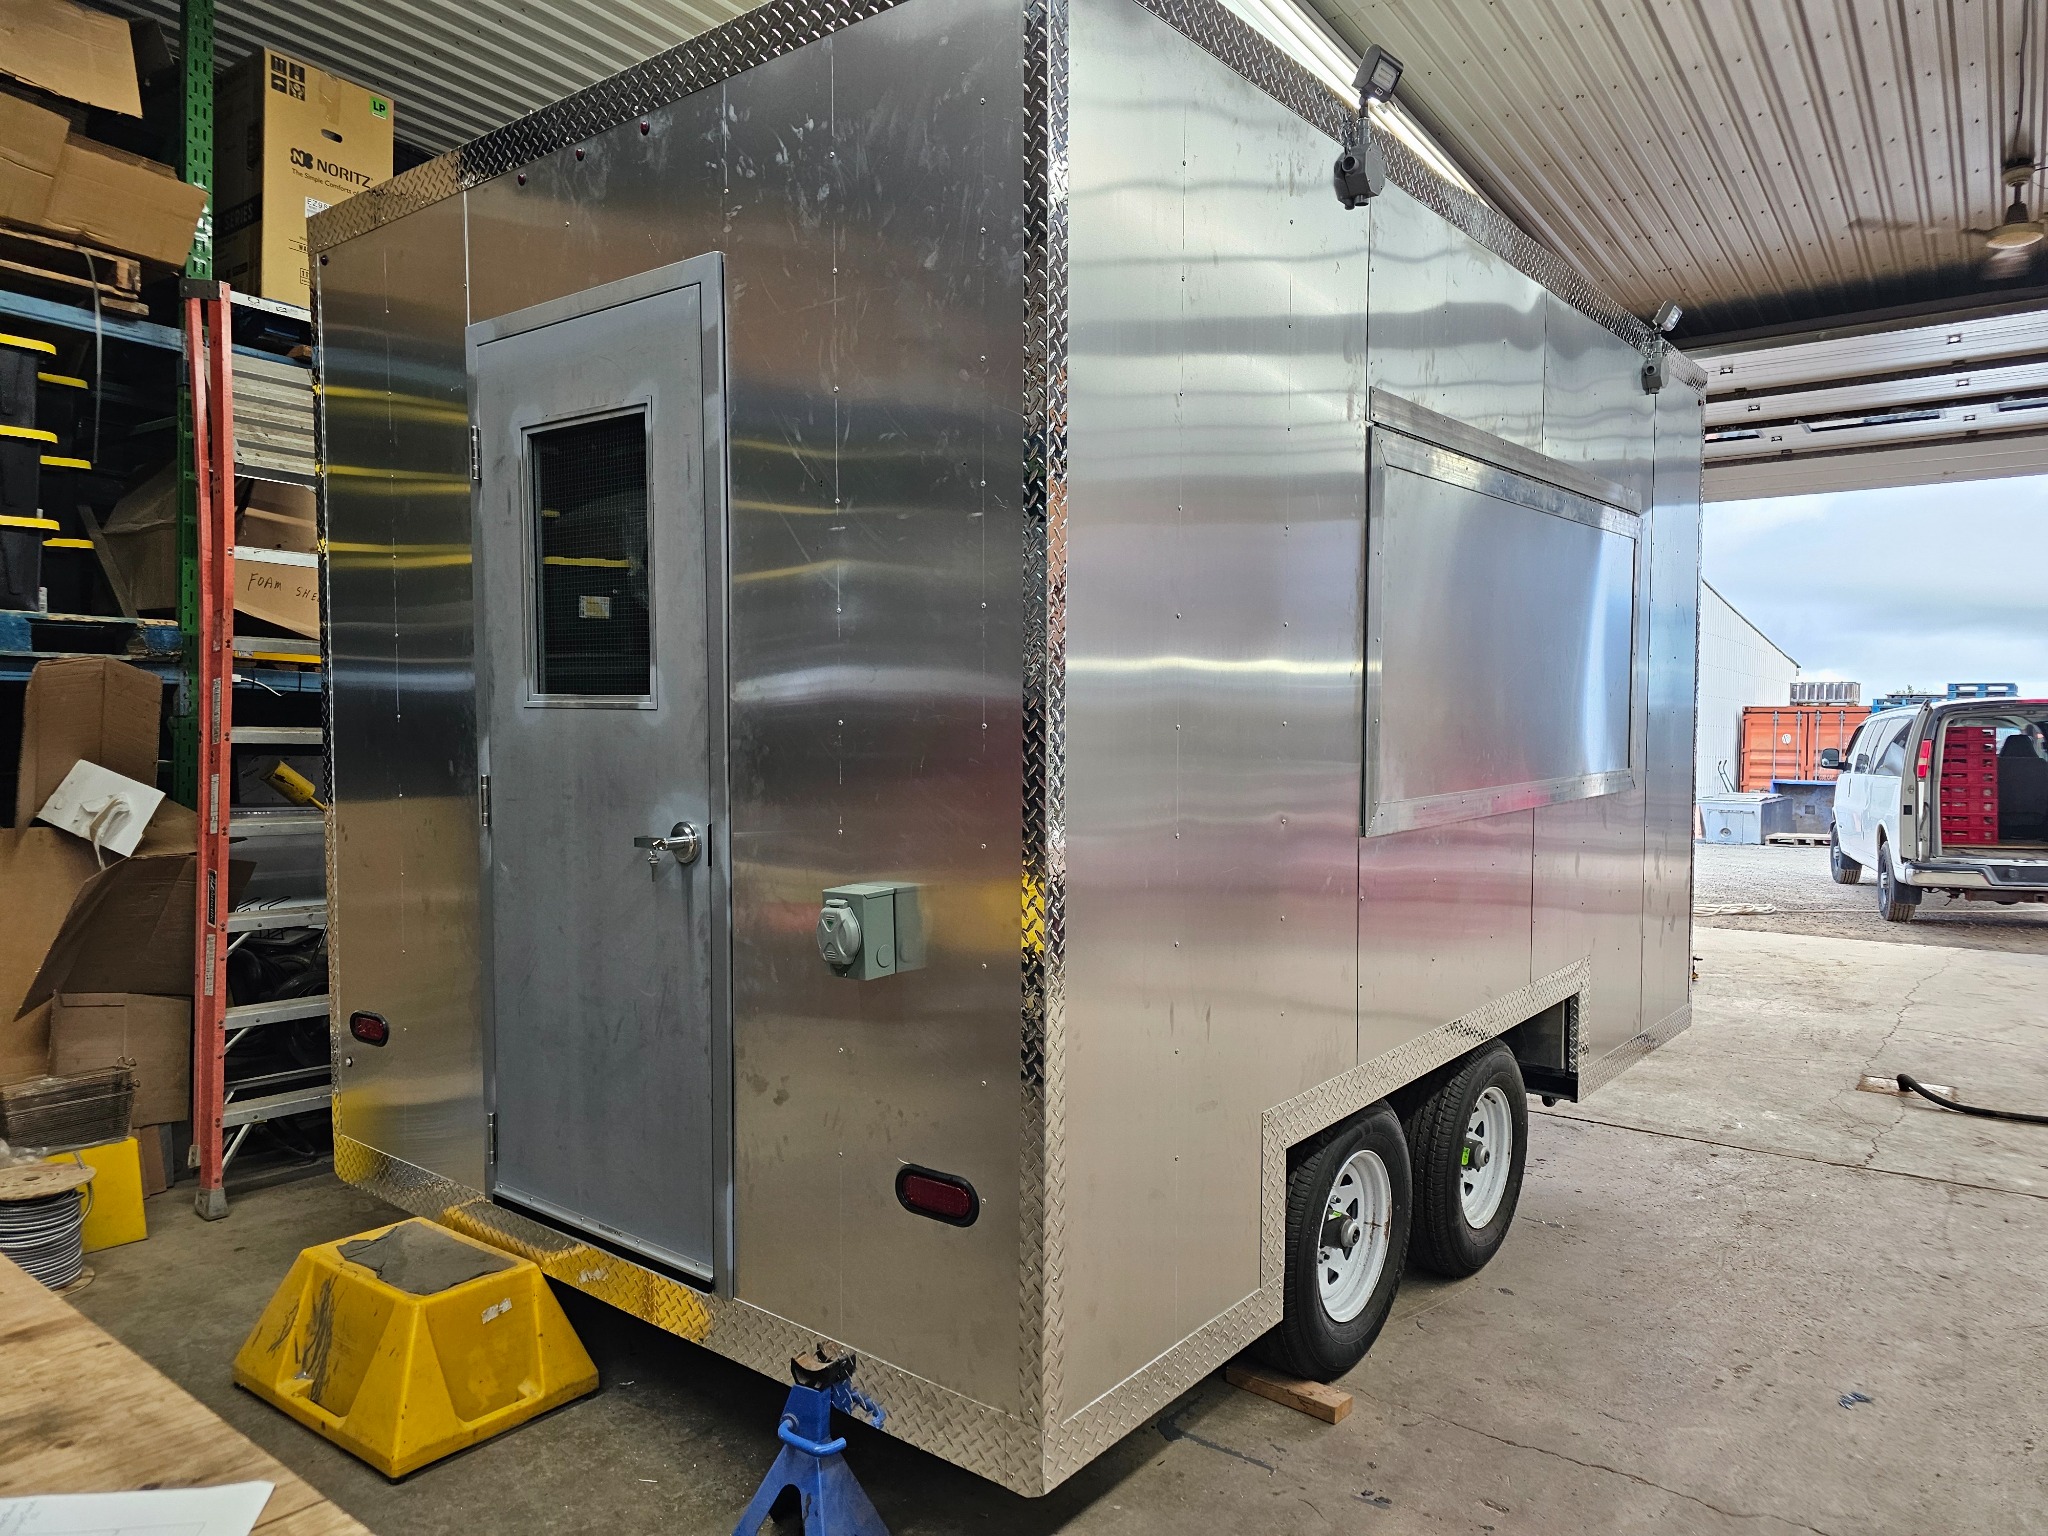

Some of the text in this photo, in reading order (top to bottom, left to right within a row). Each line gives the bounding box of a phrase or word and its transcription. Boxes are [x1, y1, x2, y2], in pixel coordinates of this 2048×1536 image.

[373, 101, 386, 112] LP
[292, 168, 303, 177] The
[304, 173, 323, 184] Simple
[325, 180, 352, 195] Comforts
[317, 158, 371, 189] NORITZ
[295, 586, 320, 603] SHE
